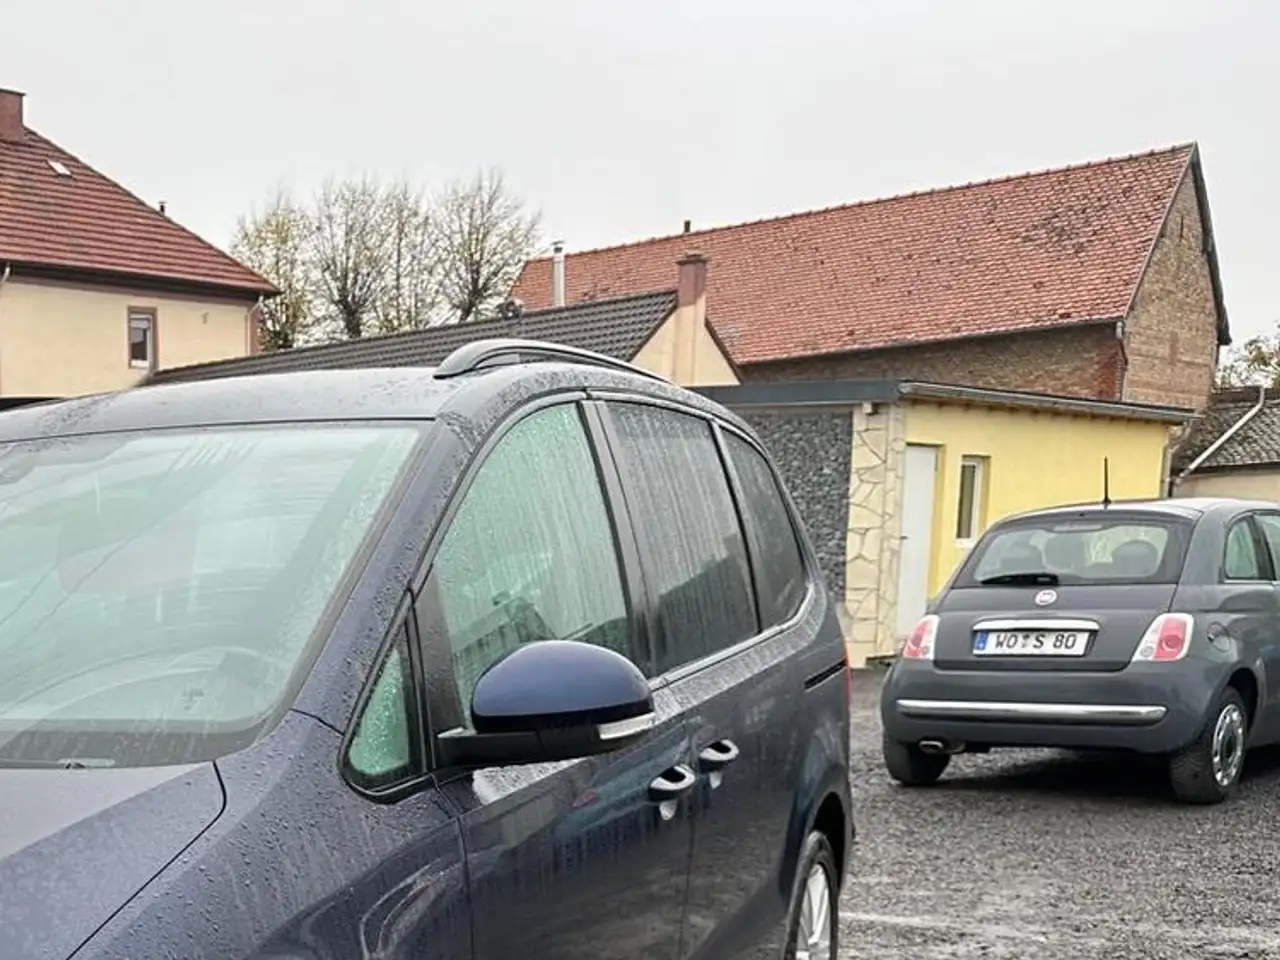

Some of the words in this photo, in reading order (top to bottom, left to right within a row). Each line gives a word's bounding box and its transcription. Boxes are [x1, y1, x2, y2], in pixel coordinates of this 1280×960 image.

[995, 633, 1018, 649] WO
[1033, 633, 1046, 649] S
[1053, 633, 1077, 649] 80
